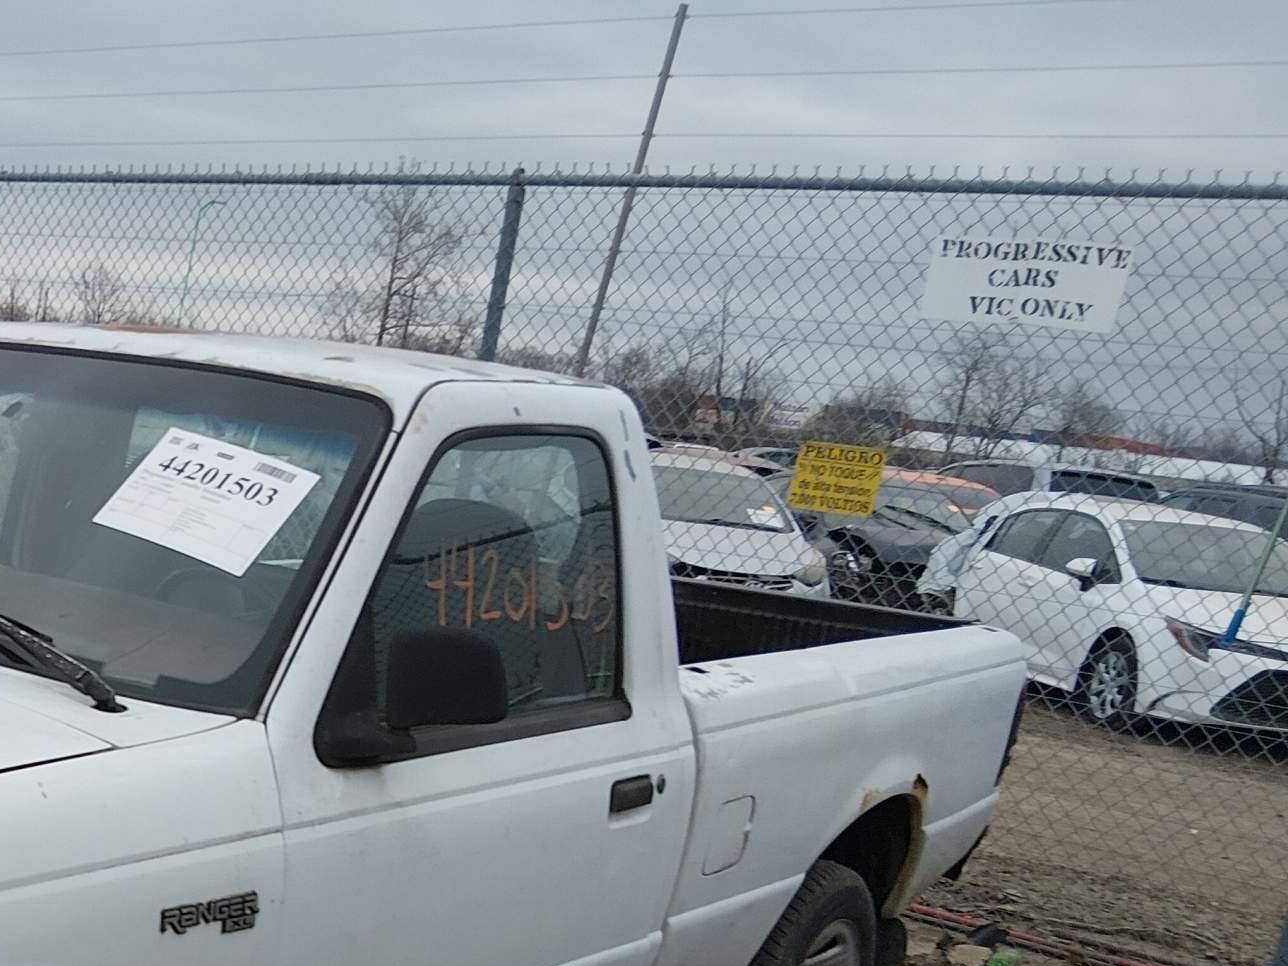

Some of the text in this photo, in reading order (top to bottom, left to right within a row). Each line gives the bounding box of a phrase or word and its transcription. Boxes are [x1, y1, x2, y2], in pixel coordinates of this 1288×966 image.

[940, 238, 1132, 269] PROGRESSIVE
[988, 268, 1060, 288] CARS
[968, 295, 1094, 322] VIC ONLY
[803, 445, 884, 466] PELIGRO
[158, 455, 279, 507] 44201503
[159, 889, 260, 935] RANGER
